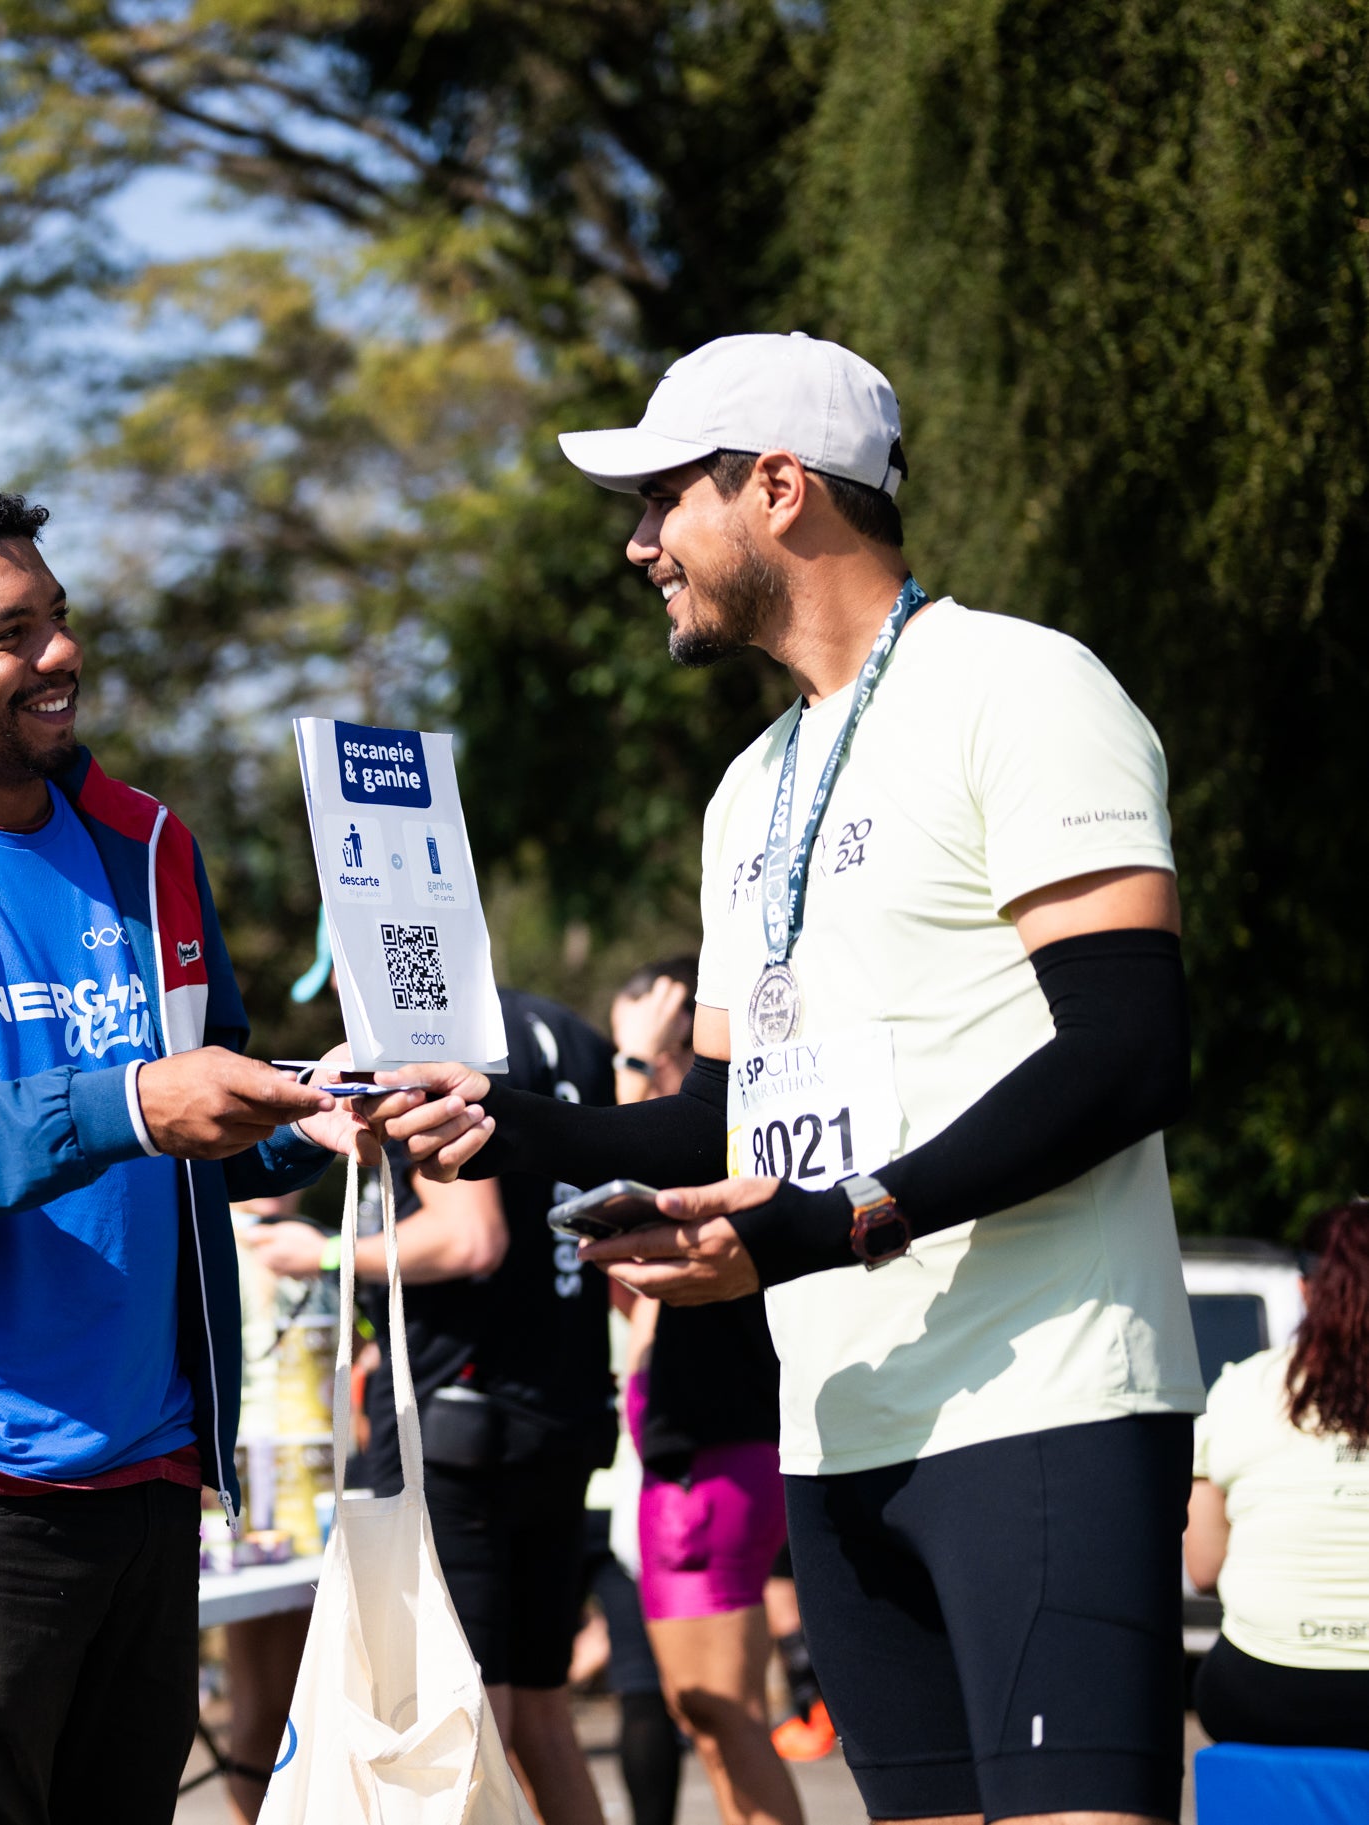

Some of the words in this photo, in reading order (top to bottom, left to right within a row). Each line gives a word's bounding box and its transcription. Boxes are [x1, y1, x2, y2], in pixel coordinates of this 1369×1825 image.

[344, 740, 414, 763] escaneie
[344, 759, 358, 784] &
[362, 764, 421, 793] ganhe
[769, 771, 794, 841] 2024
[1094, 808, 1148, 822] Uniclass
[838, 818, 873, 847] 20
[834, 843, 866, 874] 24
[339, 873, 380, 887] descarte
[427, 879, 453, 893] ganhe
[766, 844, 787, 942] SPCITY
[82, 921, 129, 950] dob
[411, 1031, 446, 1045] dobro
[746, 1043, 823, 1085] SPCITY
[752, 1106, 854, 1182] 8021
